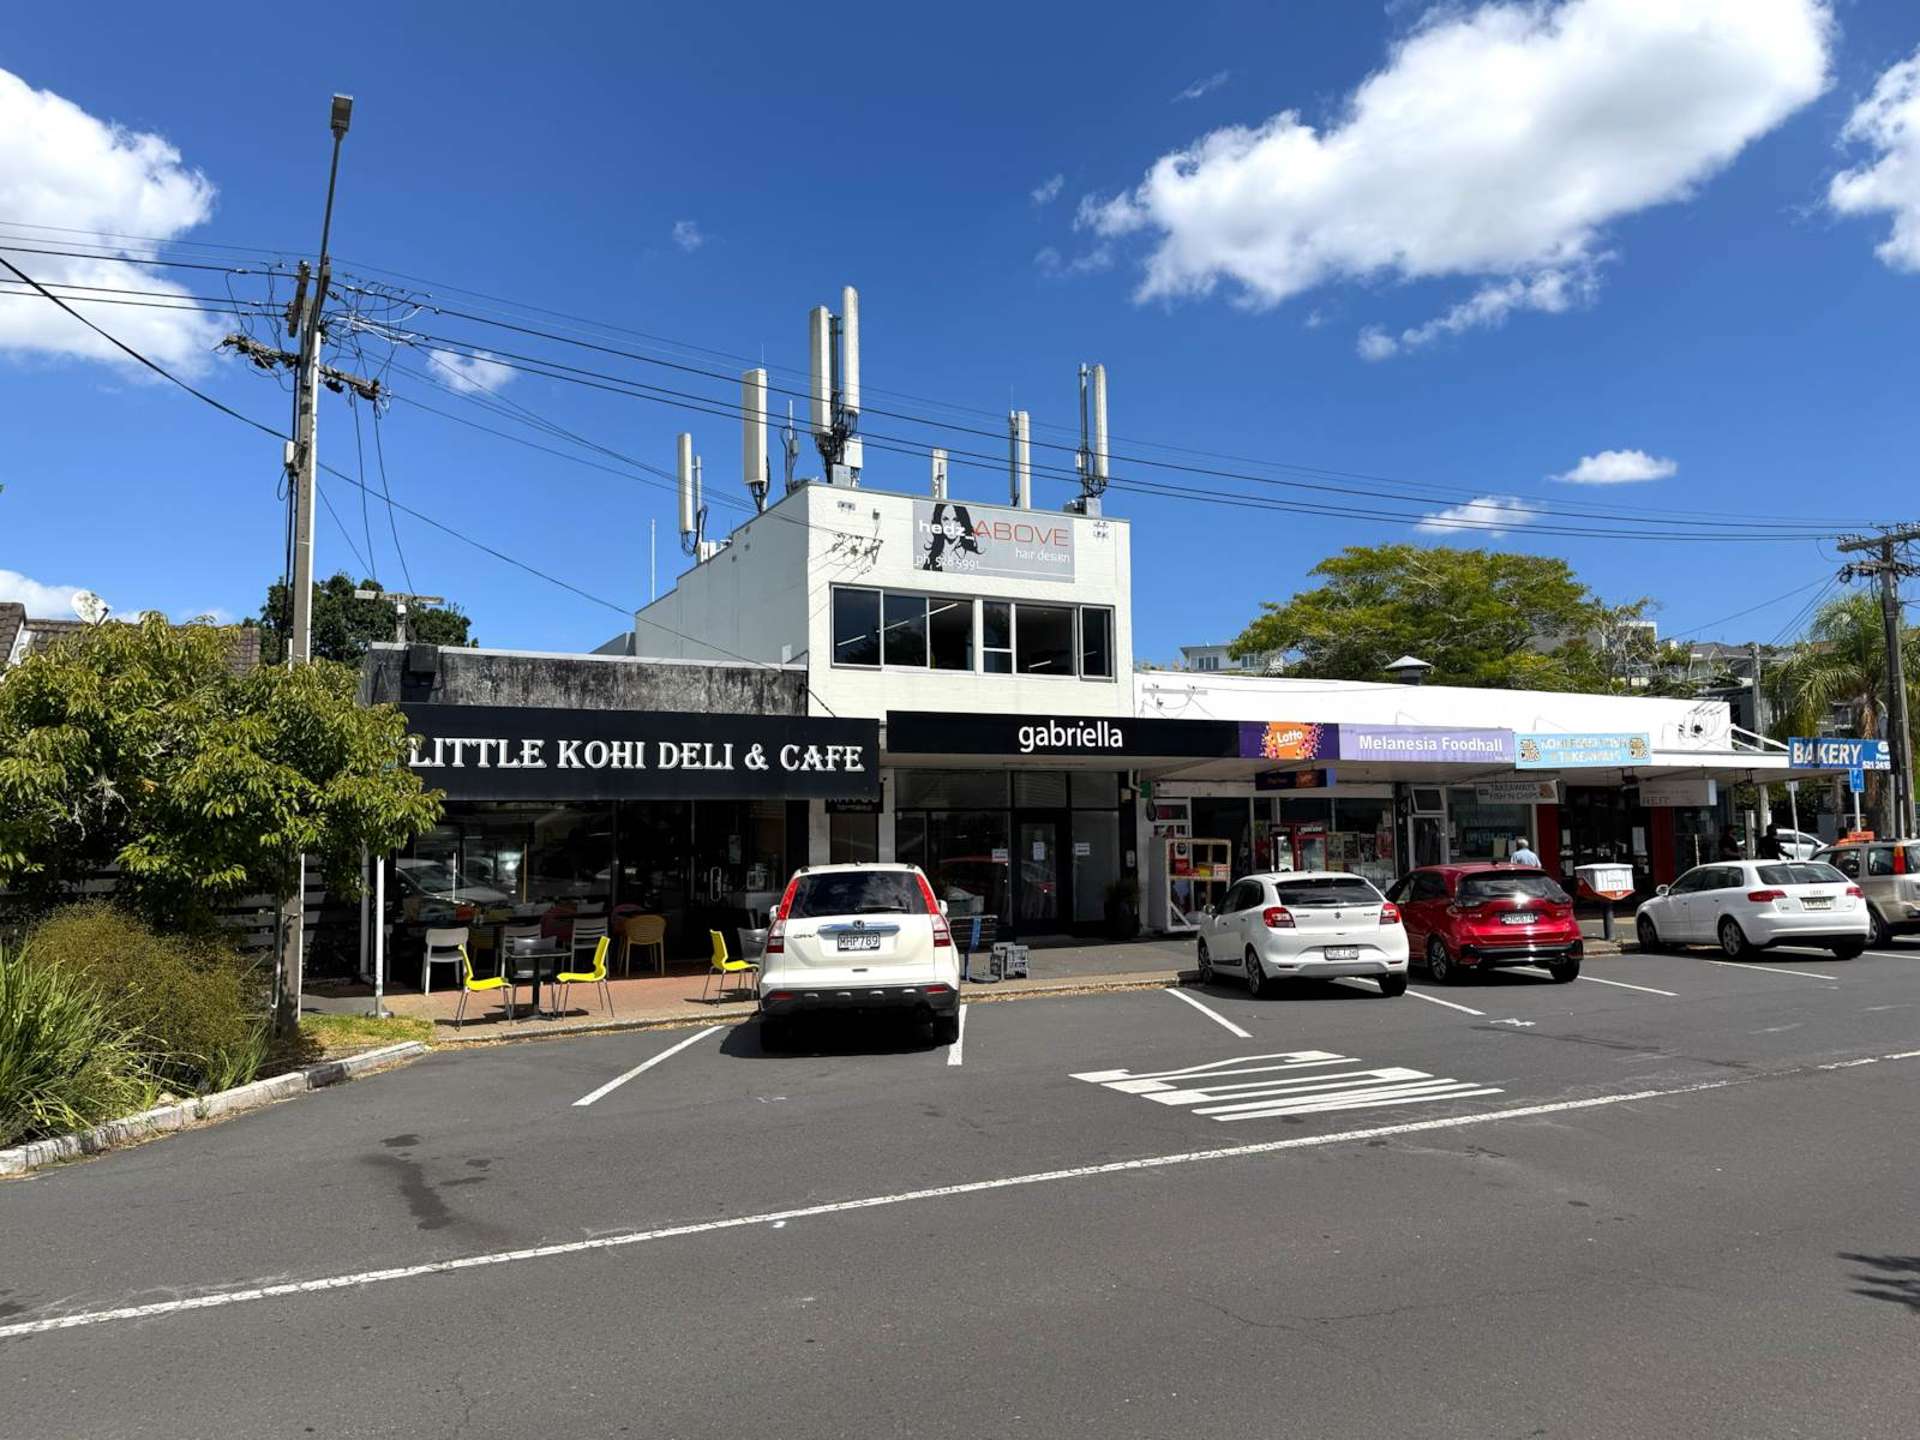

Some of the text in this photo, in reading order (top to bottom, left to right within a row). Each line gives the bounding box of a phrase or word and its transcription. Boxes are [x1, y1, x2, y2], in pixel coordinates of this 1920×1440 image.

[974, 519, 1069, 547] ABOVE
[1015, 548, 1071, 563] hair design
[1018, 719, 1123, 754] gabriella
[1276, 729, 1304, 744] Lotto
[1358, 734, 1503, 752] Melanesia Foodhall
[408, 737, 865, 772] LITTLE KOHI DELI & CAFE
[1793, 742, 1862, 765] BAKERY
